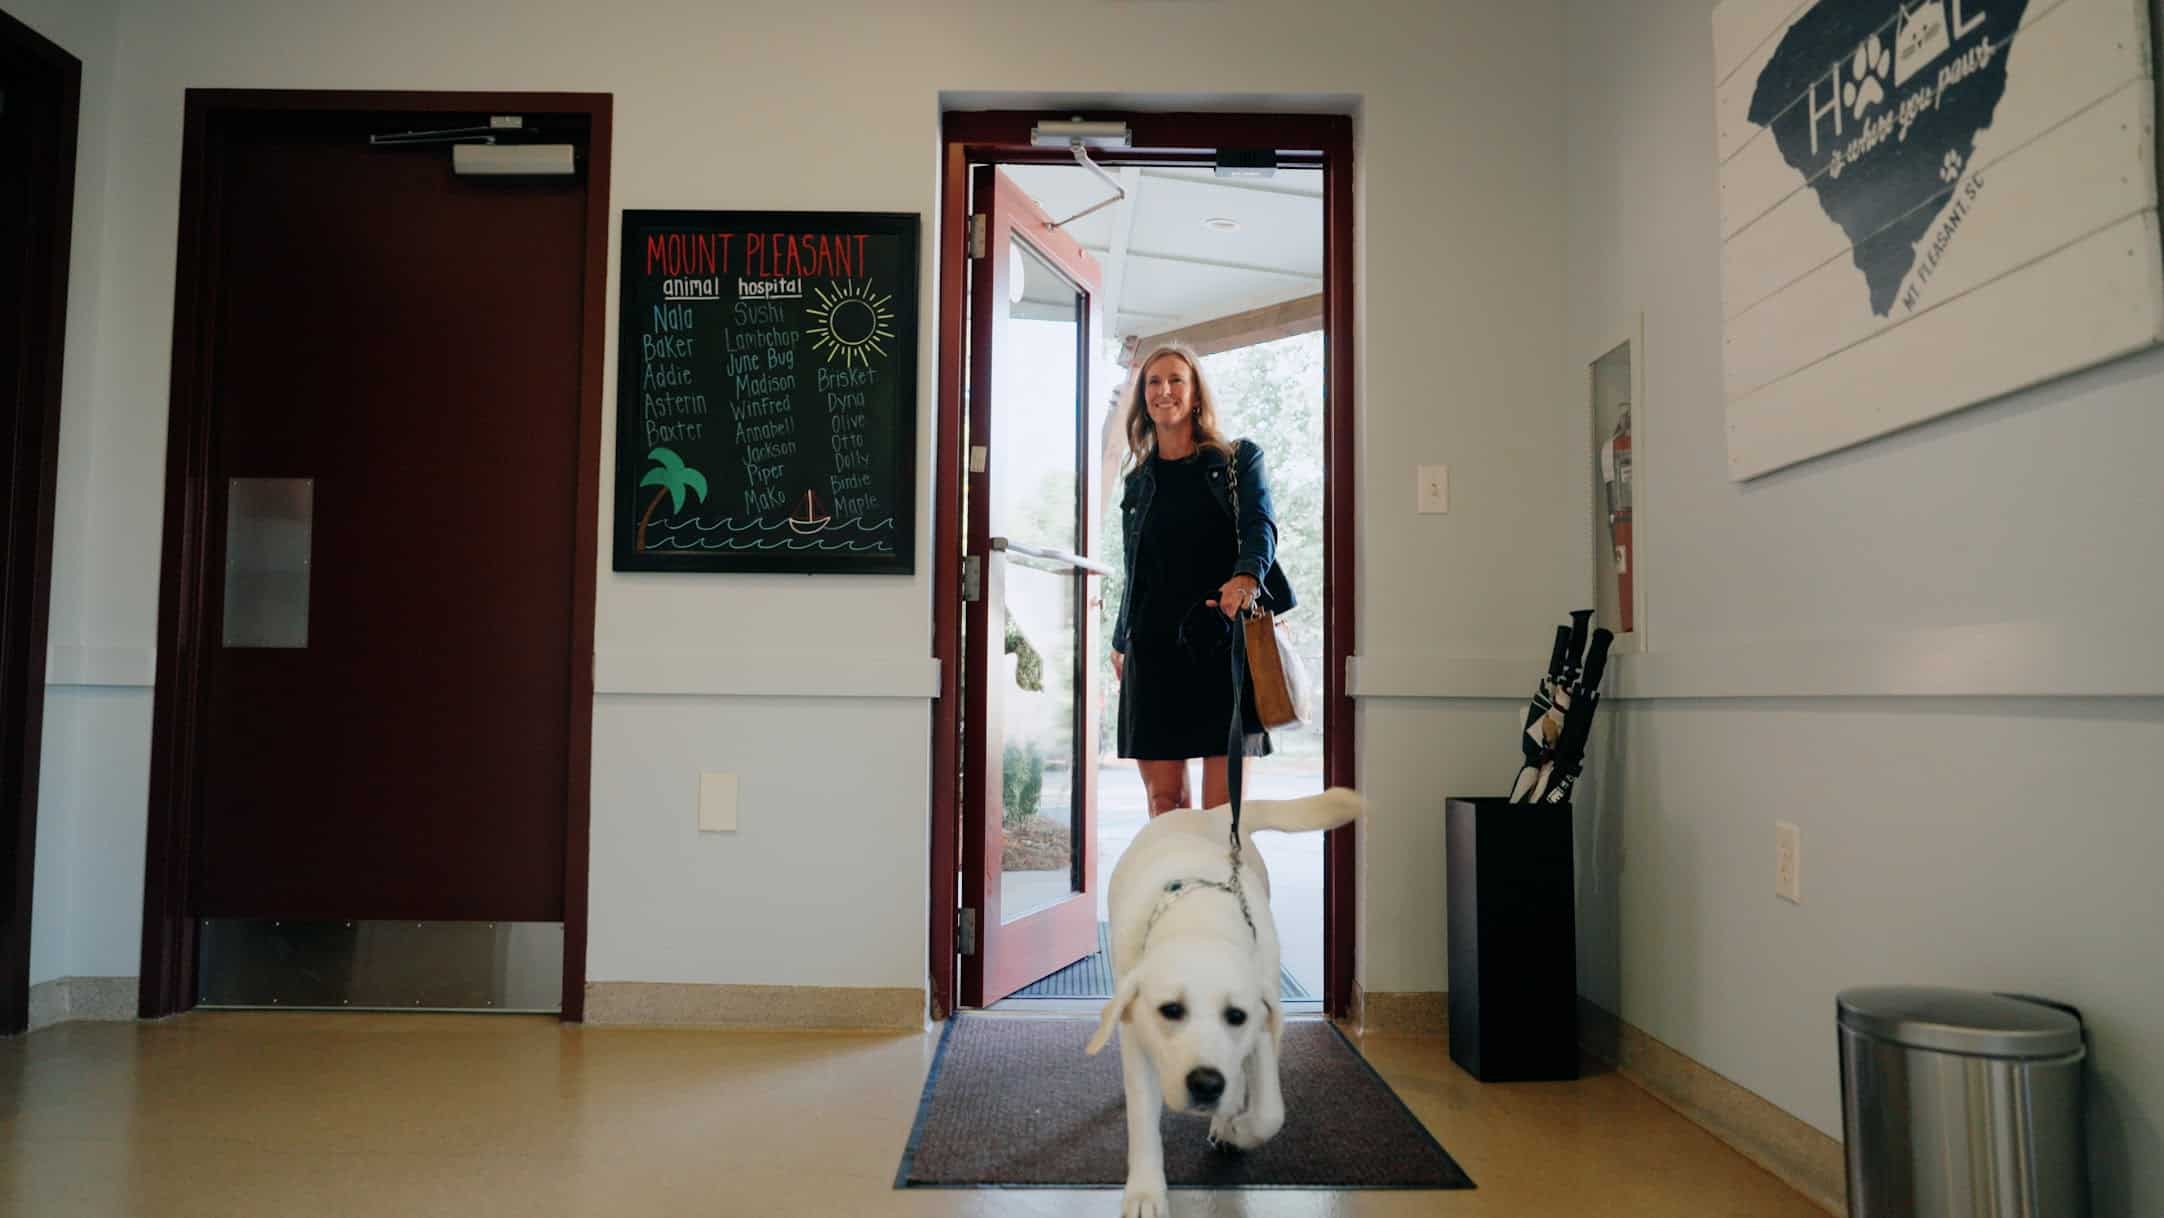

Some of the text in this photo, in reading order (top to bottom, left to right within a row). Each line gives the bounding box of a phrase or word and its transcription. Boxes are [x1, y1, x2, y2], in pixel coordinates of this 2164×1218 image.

[1965, 173, 1985, 200] SC
[647, 233, 871, 278] MOUNT PLEASANT
[663, 278, 802, 300] animal hospital
[653, 304, 693, 333] Nala
[767, 347, 794, 370] Bug
[736, 372, 796, 400] Madison
